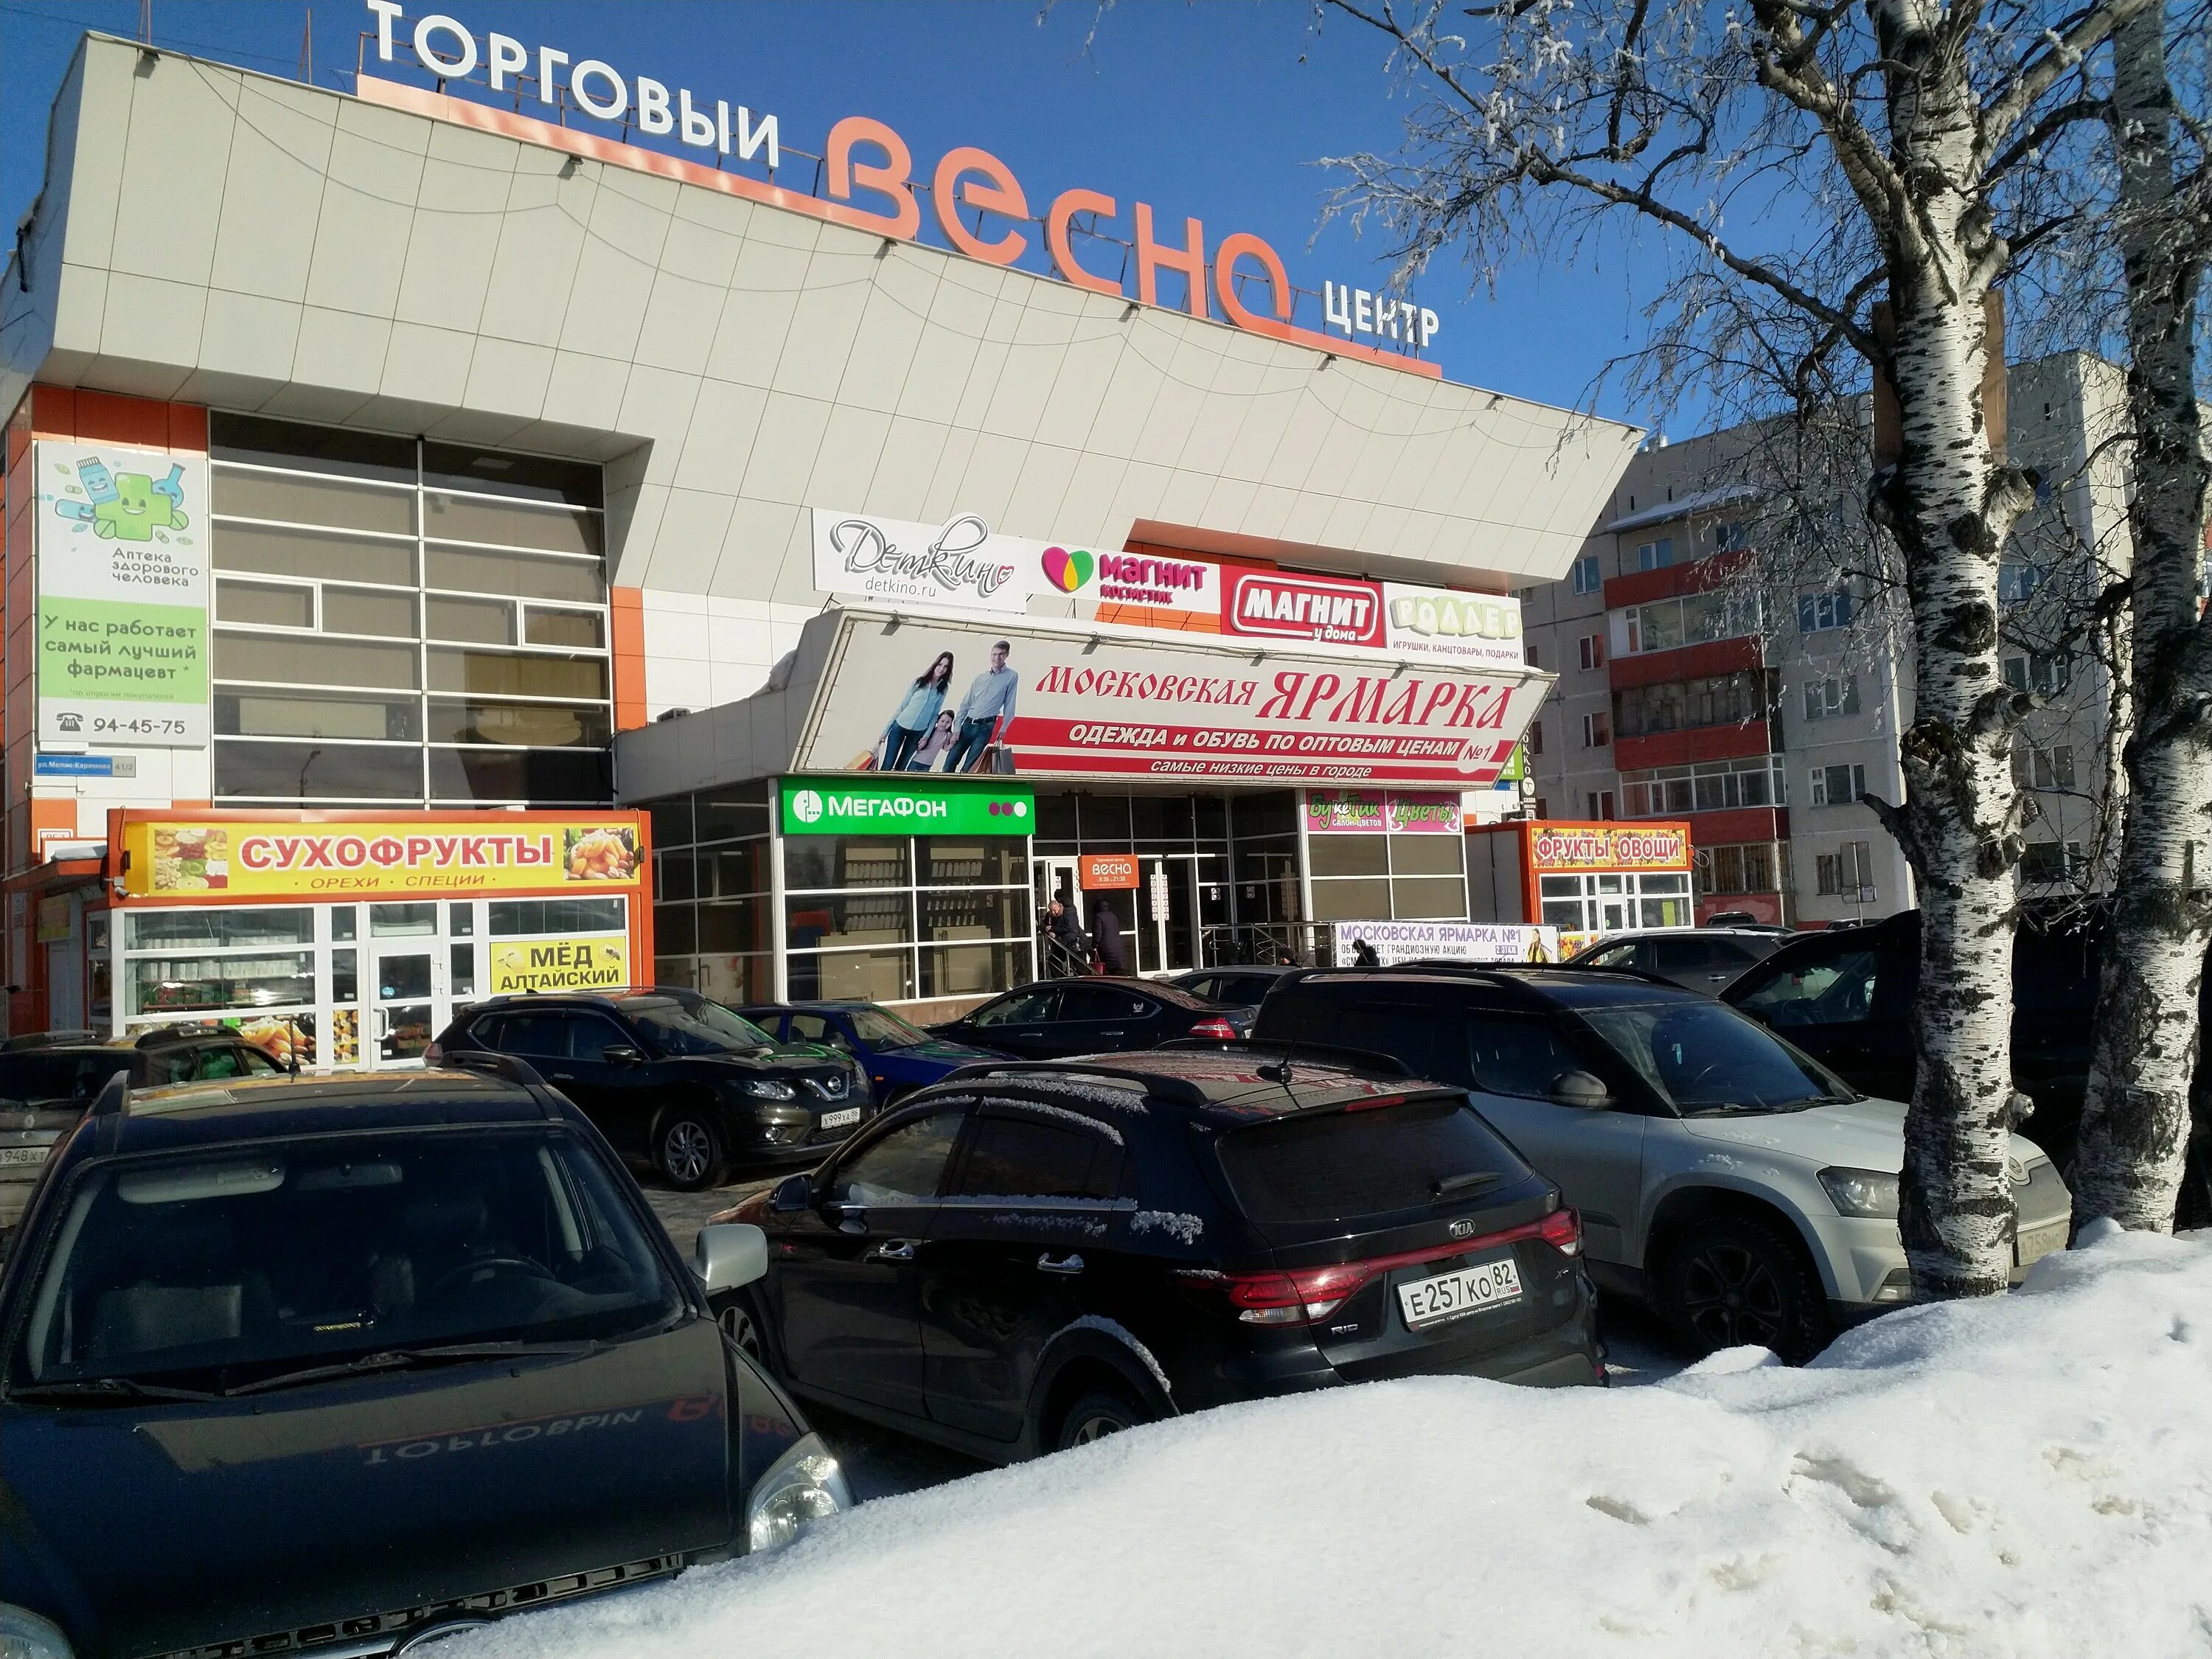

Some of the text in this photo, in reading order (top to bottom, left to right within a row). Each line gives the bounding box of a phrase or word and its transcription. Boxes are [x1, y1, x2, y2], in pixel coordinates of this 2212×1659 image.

[1322, 280, 1441, 348] ЦЕНТР
[112, 547, 172, 563] Аптека
[112, 561, 199, 576] здорового
[112, 572, 189, 587] человека
[865, 576, 936, 597] detkino.ru
[1243, 587, 1370, 628] МАГНИТ
[1398, 598, 1520, 636] РОЛЛЕР
[44, 614, 197, 638] У нас работает
[1312, 624, 1357, 642] у дома
[44, 640, 197, 661] самый лучший
[1392, 640, 1519, 660] ИГРУШКИ, КАНЦТОВАРЫ, ПОДАРКИ
[66, 659, 176, 680] фармацевт
[1255, 670, 1517, 729] ЯРМАРКА
[93, 717, 186, 734] 94-45-75
[1068, 723, 1168, 746] ОДЕЖДА
[1192, 729, 1259, 749] ОБУВЬ
[1265, 733, 1293, 751] ПО
[1301, 734, 1392, 755] ОПТОВЫМ
[1396, 738, 1461, 757] ЦЕНАМ
[1462, 743, 1492, 762] №1
[1523, 729, 1531, 775] ОККО
[1150, 759, 1372, 779] самые низкие цены в городе
[240, 836, 552, 869] СУХОФРУКТЫ
[1538, 837, 1679, 860] ФРУКТЫ ОВОЩИ
[310, 874, 484, 889] ОРЕХИ СПЕЦИИ
[1340, 925, 1521, 942] МОСКОВСКАЯ ЯРМАРКА №1
[529, 942, 593, 969] МЁД
[1388, 945, 1440, 955] ГРАНДИОЗНУЮ
[1443, 945, 1467, 955] АКЦИЮ
[499, 966, 620, 991] АЛТАЙСКИЙ
[1454, 1222, 1473, 1237] KIA
[1492, 1263, 1512, 1287] 82
[1497, 1285, 1511, 1295] RUS
[1331, 1324, 1358, 1335] RIO
